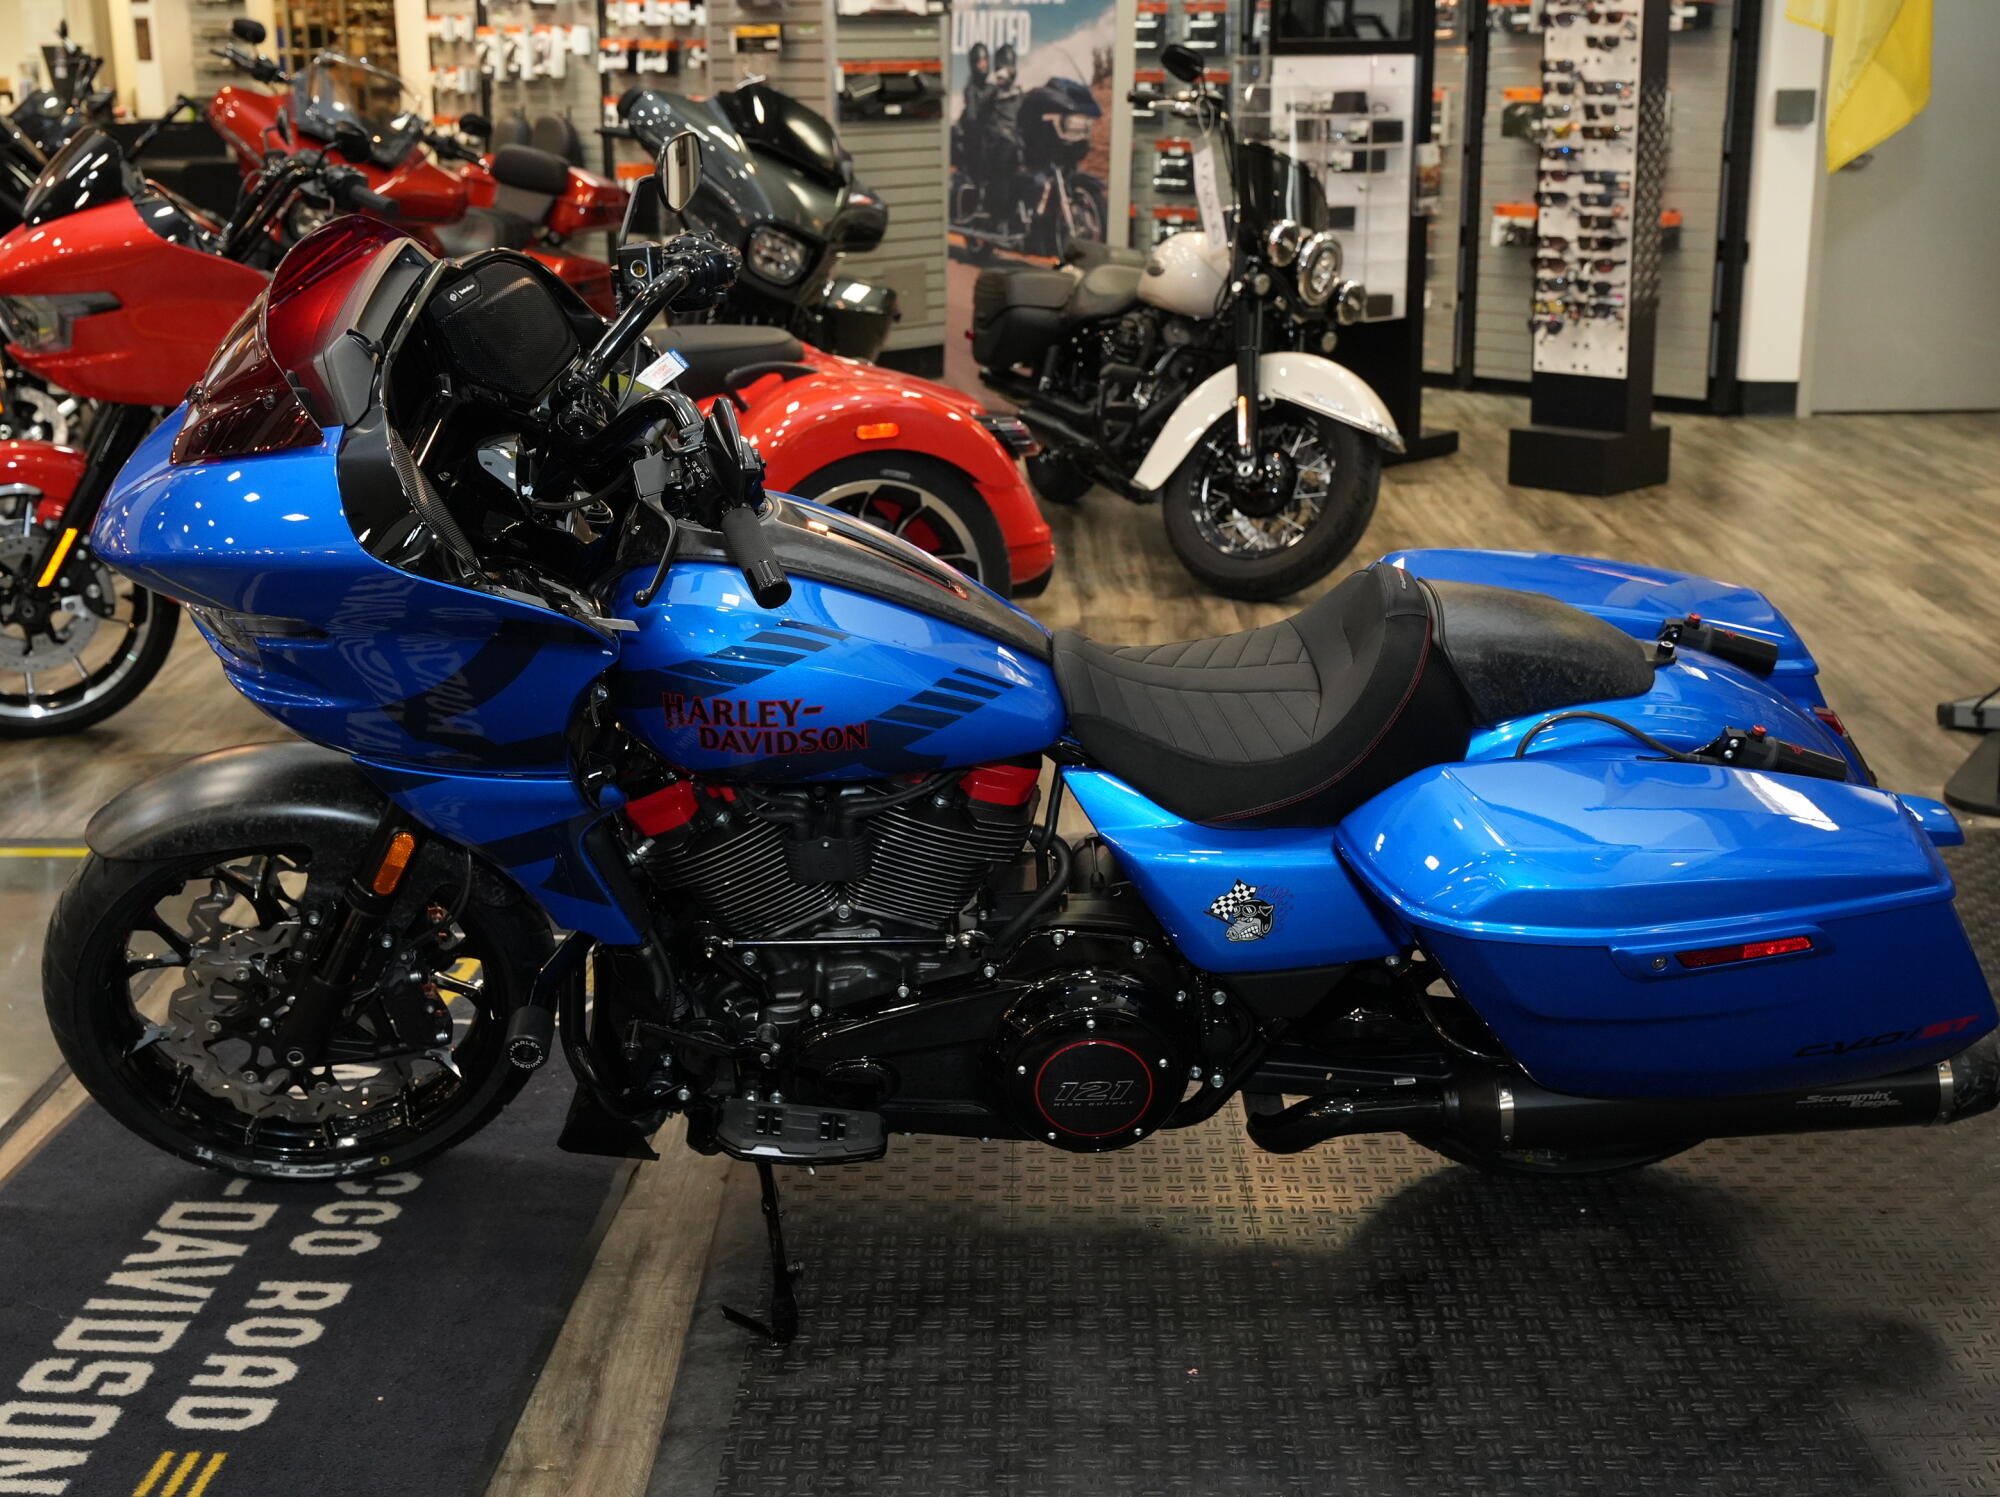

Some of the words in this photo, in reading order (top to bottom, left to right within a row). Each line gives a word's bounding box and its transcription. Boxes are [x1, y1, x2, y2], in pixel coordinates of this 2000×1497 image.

[951, 9, 1031, 56] LIMITED
[662, 691, 825, 728] HARLEY-
[698, 722, 868, 755] DAVIDSON
[1054, 1080, 1135, 1101] 121
[165, 1280, 353, 1432] ROAD
